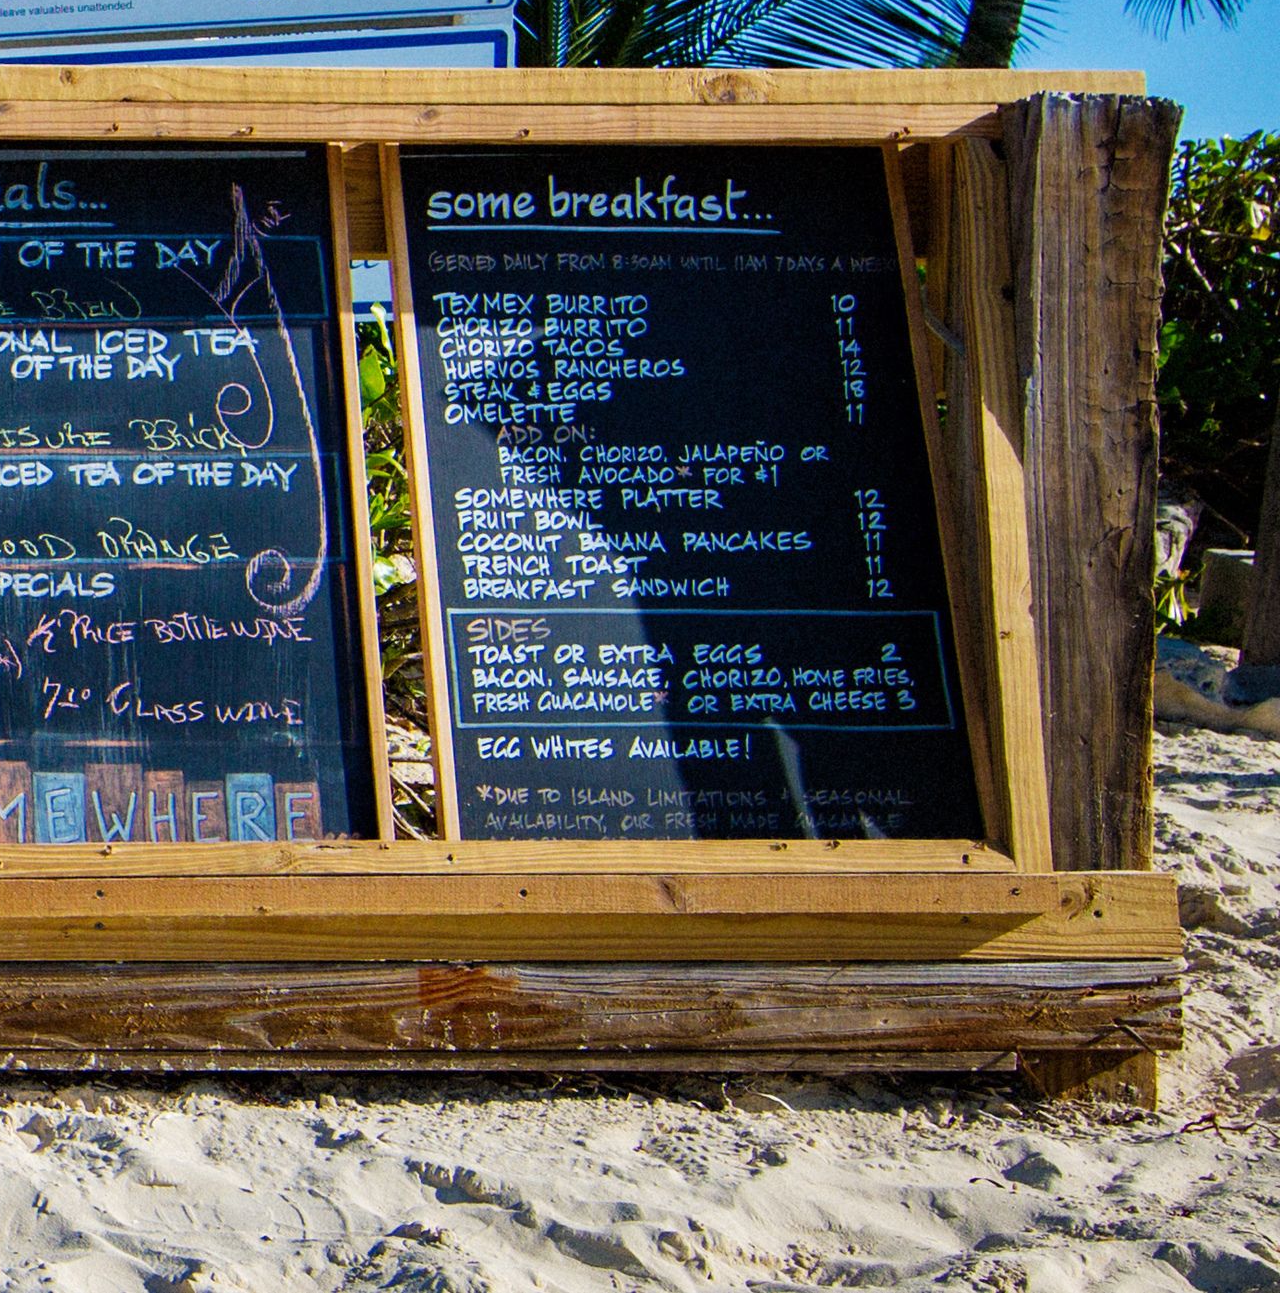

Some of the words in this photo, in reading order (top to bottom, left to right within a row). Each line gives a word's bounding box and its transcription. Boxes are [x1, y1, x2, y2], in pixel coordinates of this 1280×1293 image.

[427, 189, 536, 218] some
[548, 174, 773, 221] breakfast...
[20, 241, 65, 267] OF
[77, 241, 136, 268] THE
[155, 240, 220, 267] DAY
[436, 318, 533, 338] CHORIZO
[544, 317, 647, 337] BURRITO
[835, 318, 854, 336] 11
[95, 329, 168, 355] ICED
[185, 328, 259, 355] TEA
[443, 381, 515, 402] STEAK
[547, 382, 613, 402] EGGS
[843, 380, 865, 399] 18
[444, 403, 576, 425] OMELETTE
[846, 405, 864, 424] 11
[69, 463, 121, 485] TEA
[132, 462, 175, 485] OF
[176, 463, 234, 485] THE
[241, 463, 297, 491] DAY
[454, 489, 602, 511] SOMEWHERE
[622, 488, 724, 511] PLATTER
[855, 490, 885, 509] 12
[458, 511, 529, 531] FRUIT
[535, 510, 602, 532] BOWL
[857, 512, 886, 529] 12
[457, 533, 559, 553] COCONUT
[579, 533, 666, 553] BANANA
[683, 532, 812, 552] PANCAKES
[863, 533, 882, 552] 11
[462, 555, 551, 577] FRENCH
[565, 555, 647, 576] TOAST
[864, 556, 883, 575] 11
[463, 578, 594, 600] BREAKFAST
[611, 577, 731, 598] SANDWICH
[867, 579, 894, 598] 12
[465, 618, 551, 643] SIDES
[469, 644, 544, 665] TOAST
[553, 644, 586, 665] OR
[598, 643, 674, 665] EXTRA
[693, 644, 763, 664] EGGS
[880, 645, 902, 661] 2
[478, 737, 526, 758] EGG
[533, 735, 614, 758] WHITES
[627, 734, 752, 759] AVAILABLE!
